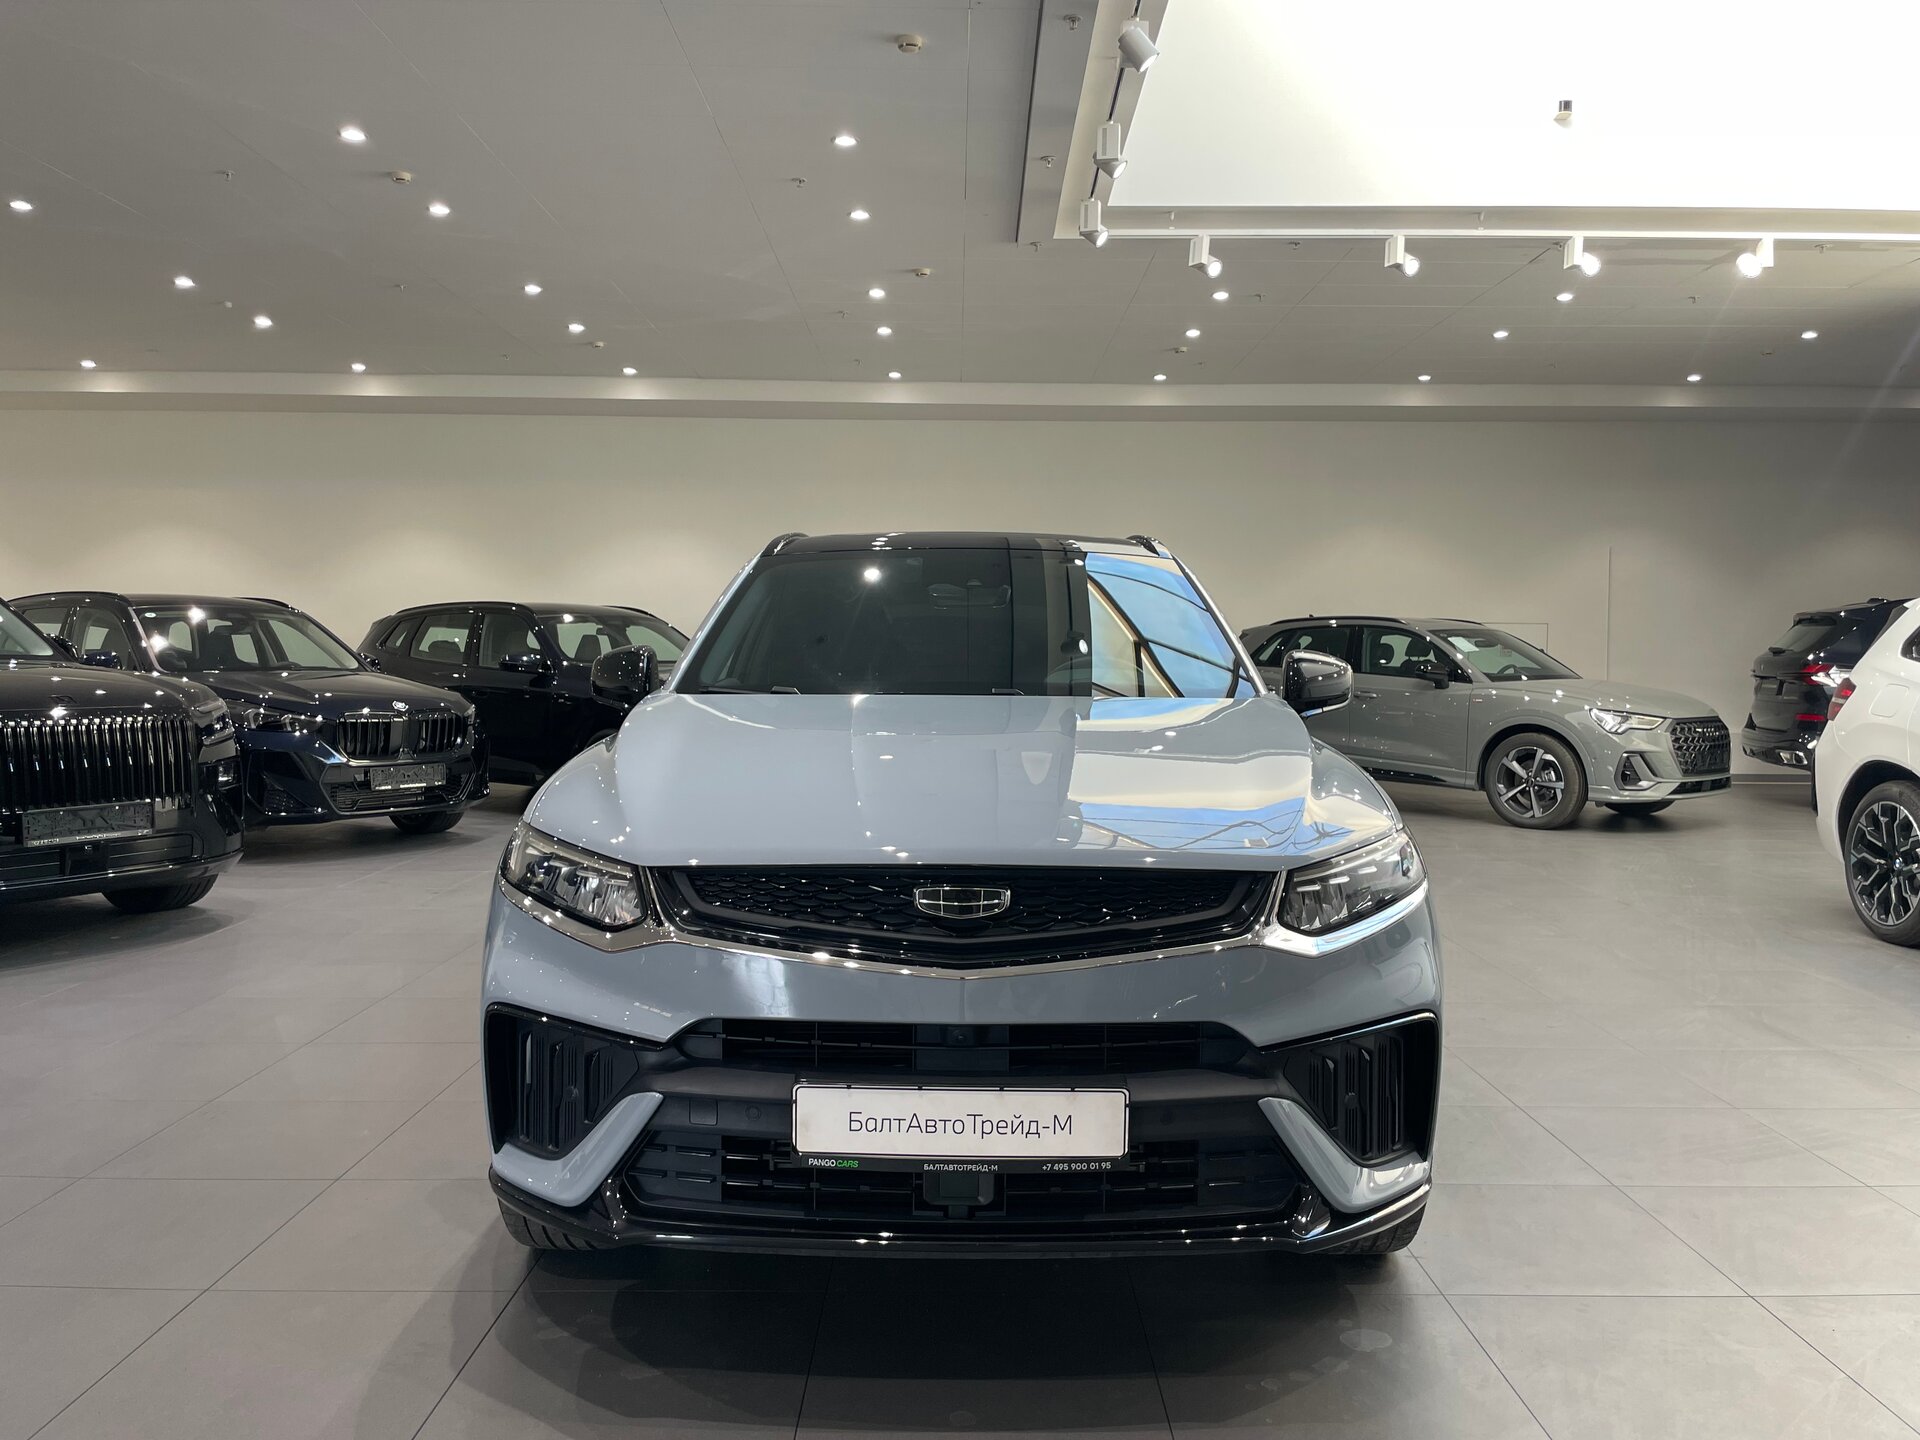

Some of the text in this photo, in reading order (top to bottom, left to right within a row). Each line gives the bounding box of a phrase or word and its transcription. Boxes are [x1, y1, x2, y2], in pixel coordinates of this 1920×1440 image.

[848, 1111, 1073, 1139] БалтАвтоТрейд-М
[1042, 1161, 1112, 1171] +7 495 900 01 95
